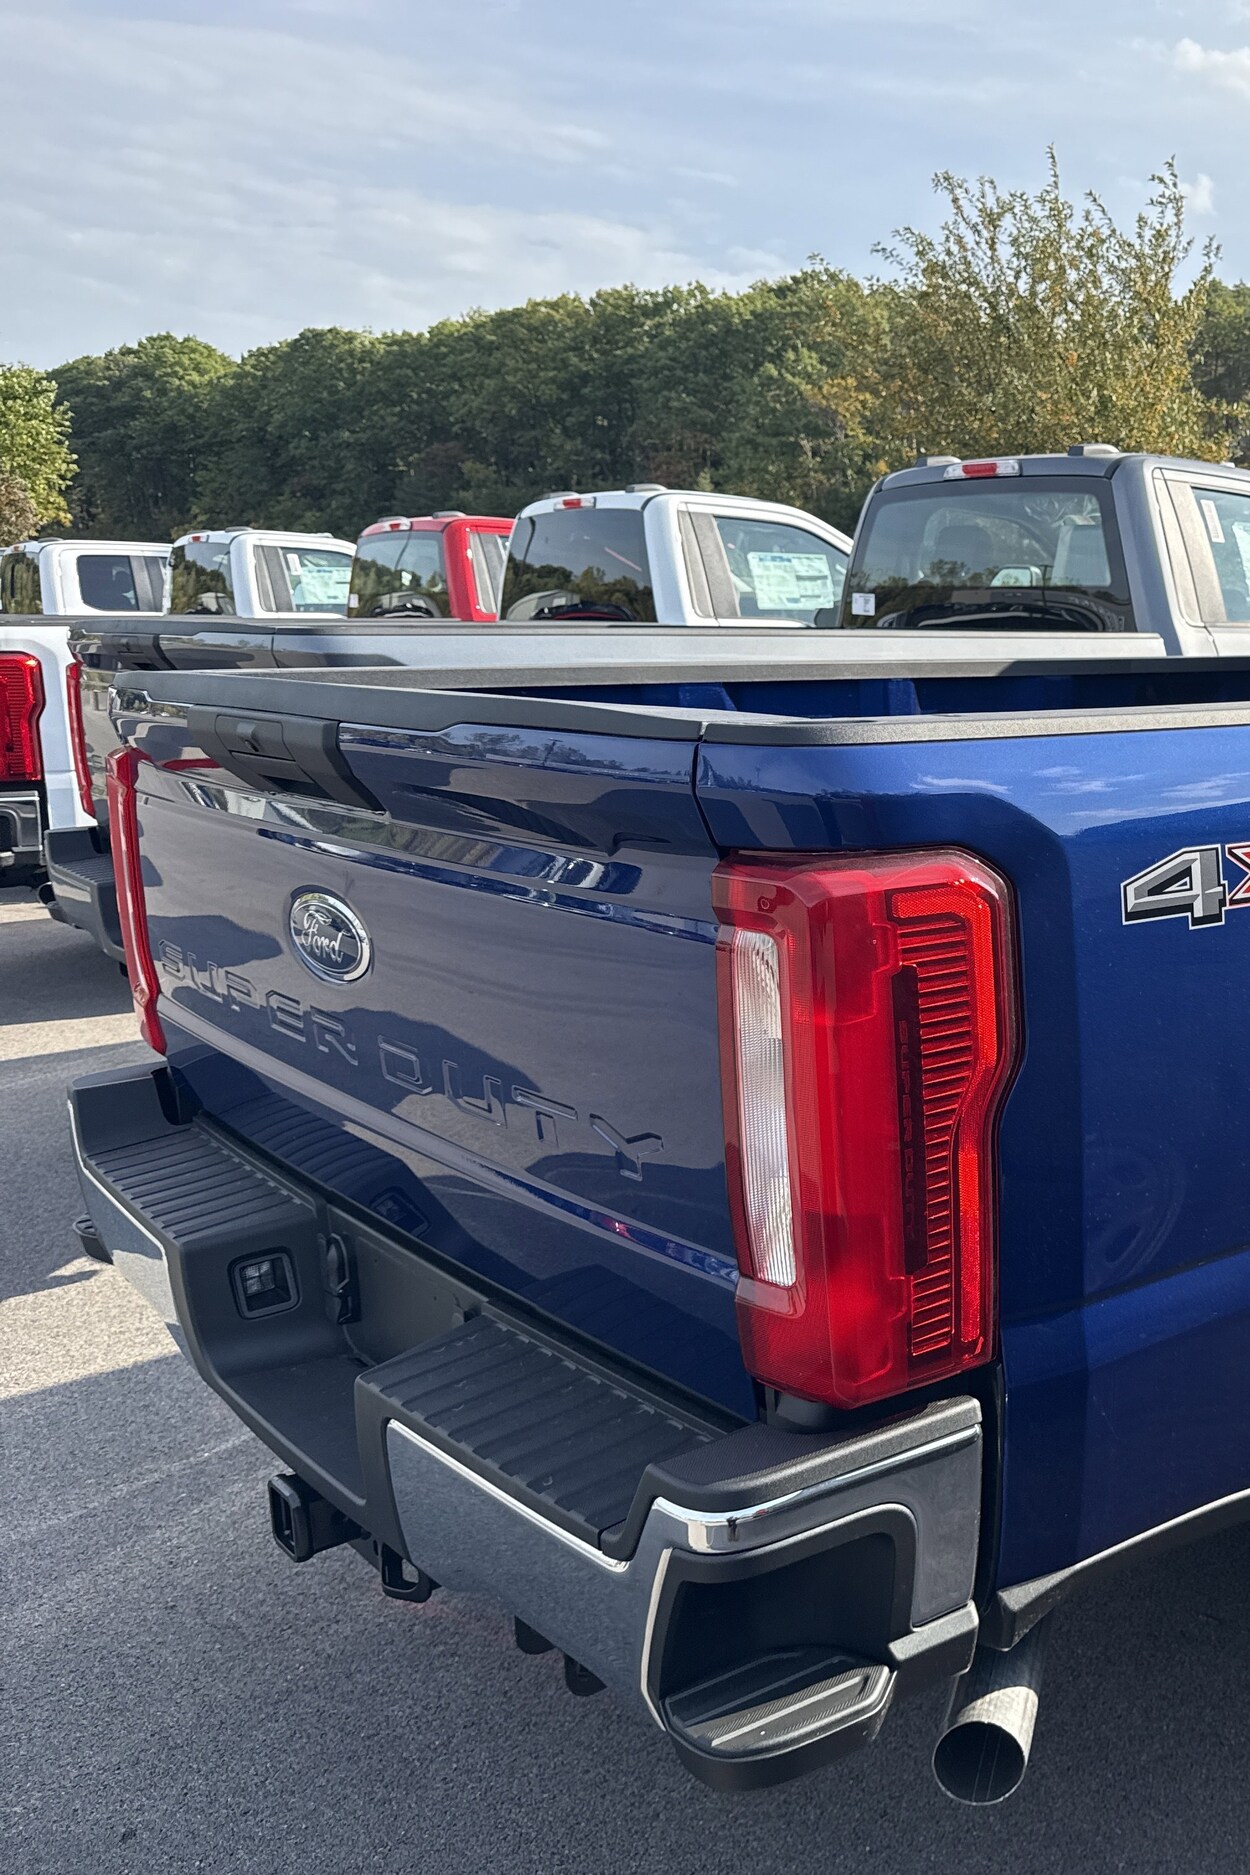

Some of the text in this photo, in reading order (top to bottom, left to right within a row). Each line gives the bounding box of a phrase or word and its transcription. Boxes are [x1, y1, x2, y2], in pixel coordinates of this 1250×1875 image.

[301, 910, 352, 964] Ford
[158, 938, 664, 1182] SUPER DUTY
